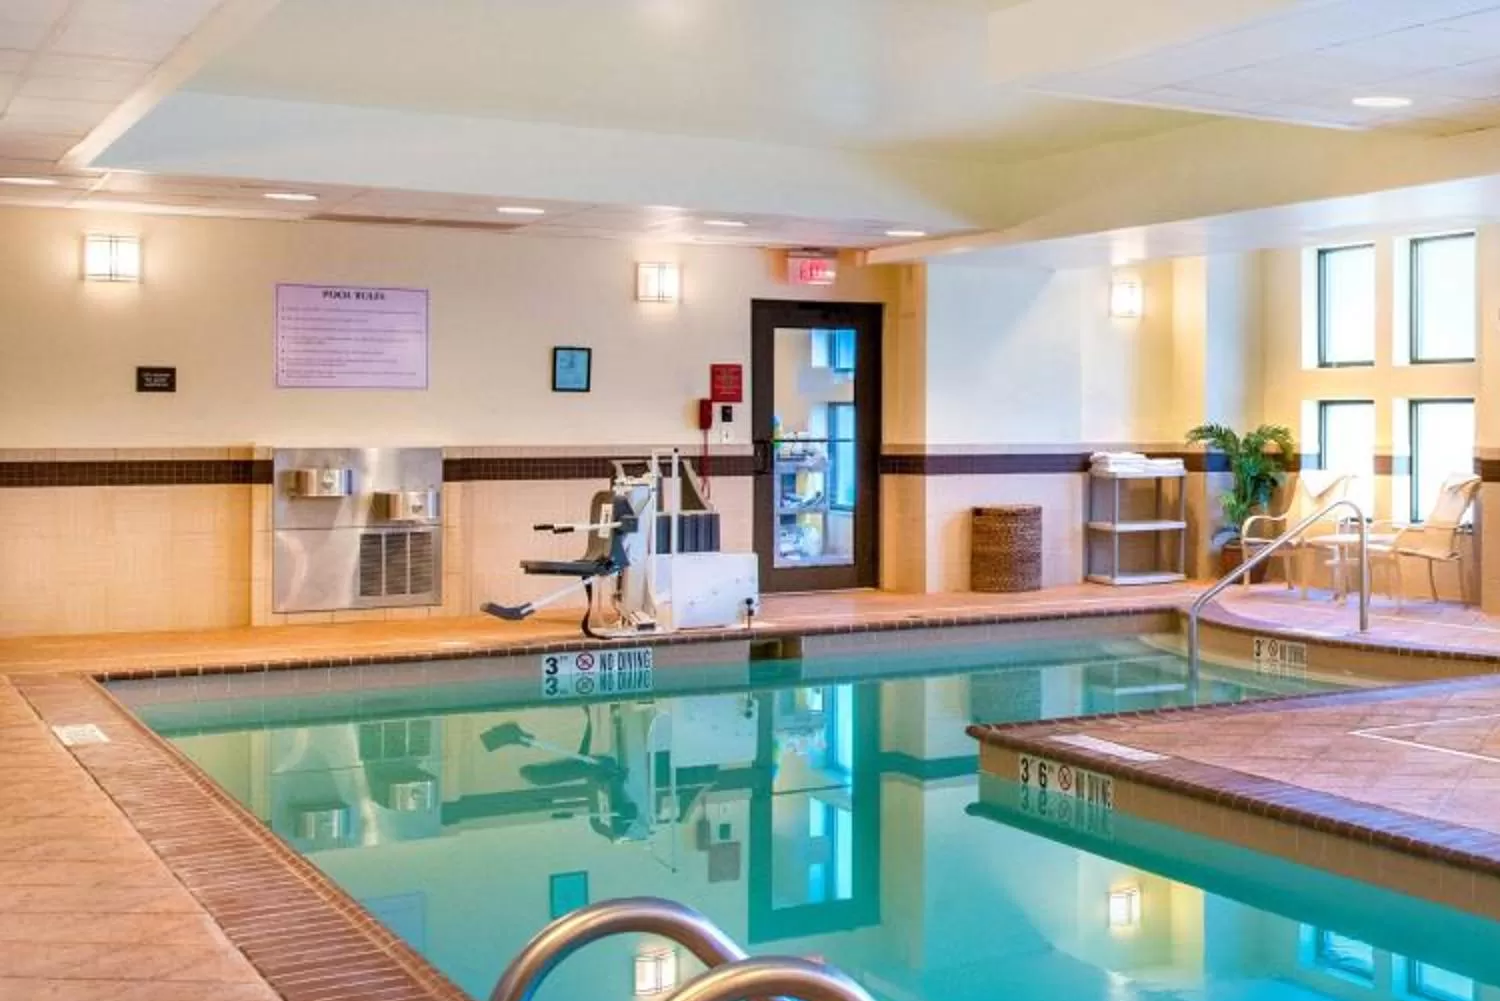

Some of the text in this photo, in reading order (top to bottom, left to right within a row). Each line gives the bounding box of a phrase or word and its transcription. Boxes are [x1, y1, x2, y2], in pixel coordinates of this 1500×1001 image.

[545, 657, 558, 674] 3
[1021, 758, 1029, 783] 3
[1039, 762, 1048, 788] 6
